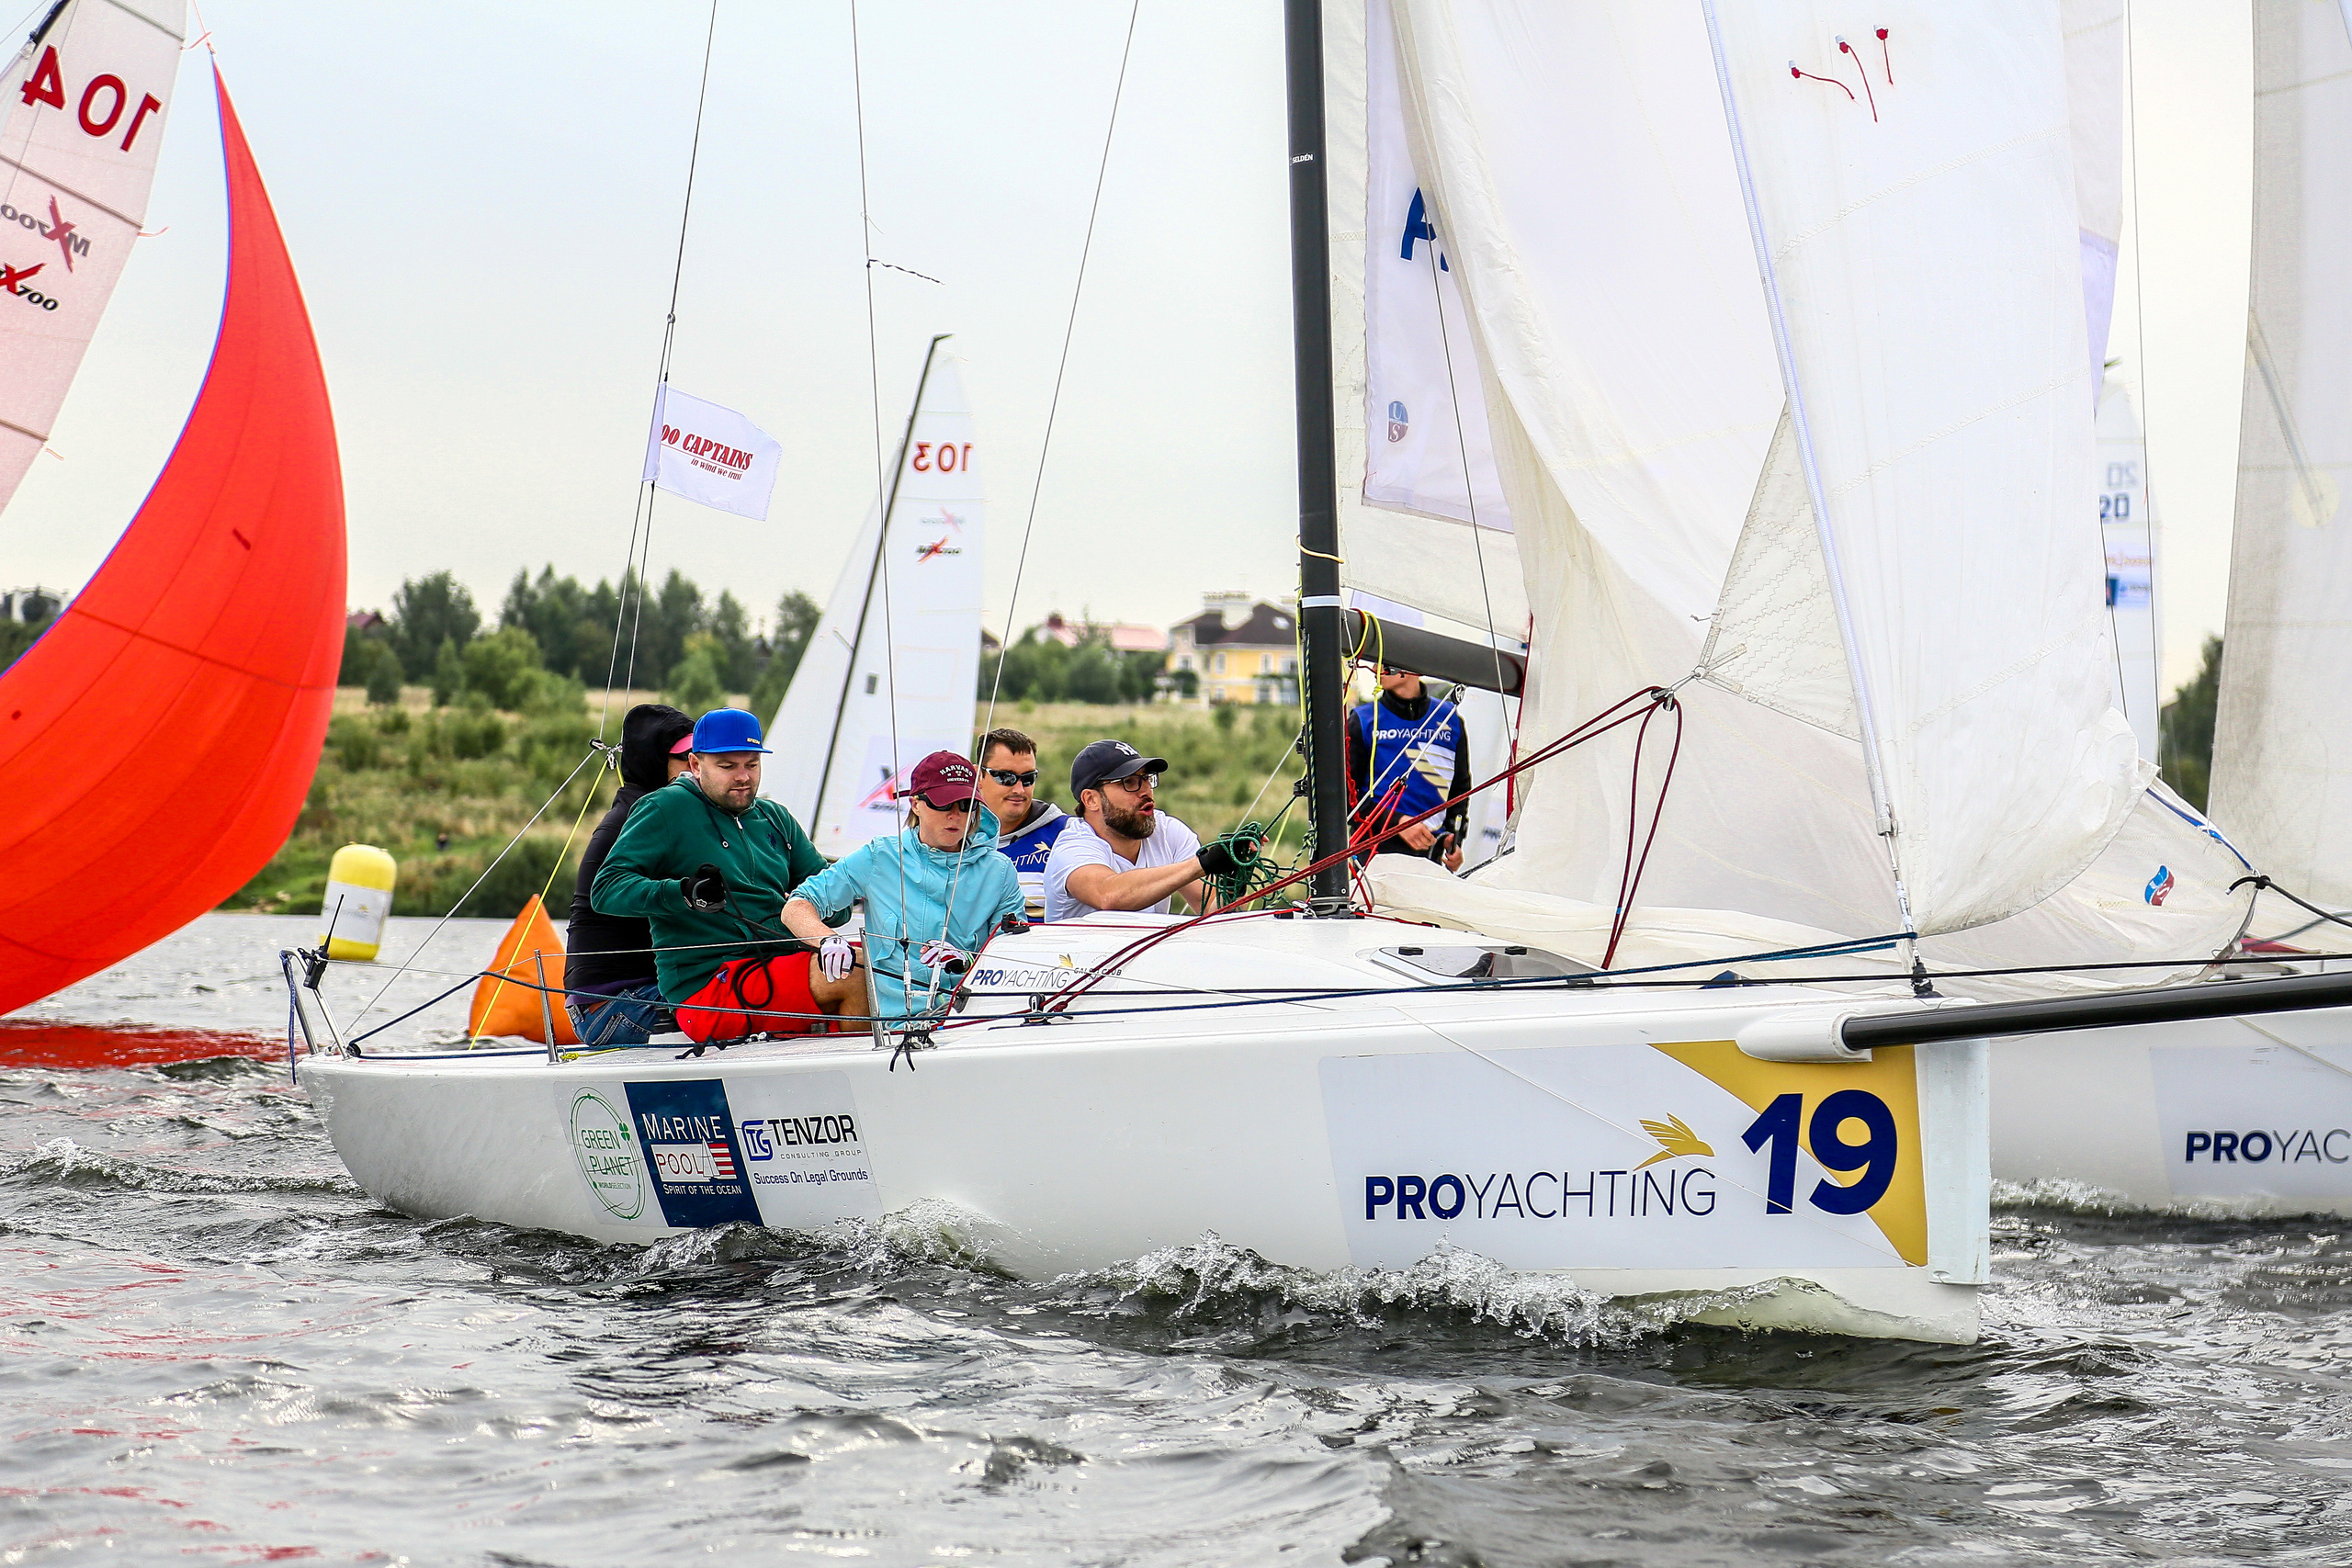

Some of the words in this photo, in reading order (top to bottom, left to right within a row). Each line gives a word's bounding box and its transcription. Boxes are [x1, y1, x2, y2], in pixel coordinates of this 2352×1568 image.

[1292, 153, 1314, 164] SELDÉN
[0, 262, 59, 311] X700
[683, 434, 753, 470] CAPTAINS
[690, 457, 699, 467] in
[700, 461, 717, 474] wind
[718, 468, 728, 477] we
[727, 471, 742, 481] trust
[939, 764, 974, 777] HARVARD
[970, 969, 1070, 989] PROYACHTING
[641, 1112, 727, 1141] MARINE
[766, 1114, 858, 1146] TENZOR
[581, 1129, 621, 1150] GREEN
[2184, 1128, 2352, 1165] PROYAC
[780, 1152, 830, 1160] CONSULTING
[834, 1149, 862, 1157] GROUP
[1740, 1089, 1899, 1216] 19
[589, 1155, 634, 1177] PLANET
[655, 1153, 704, 1175] POOL
[753, 1171, 789, 1186] Success
[789, 1170, 804, 1184] On
[803, 1169, 828, 1187] Legal
[829, 1167, 869, 1183] Grounds
[662, 1183, 687, 1195] SPIRIT
[687, 1185, 699, 1195] OF
[698, 1185, 716, 1195] THE
[717, 1185, 742, 1195] OCEAN
[1364, 1167, 1717, 1222] PROYACHTING
